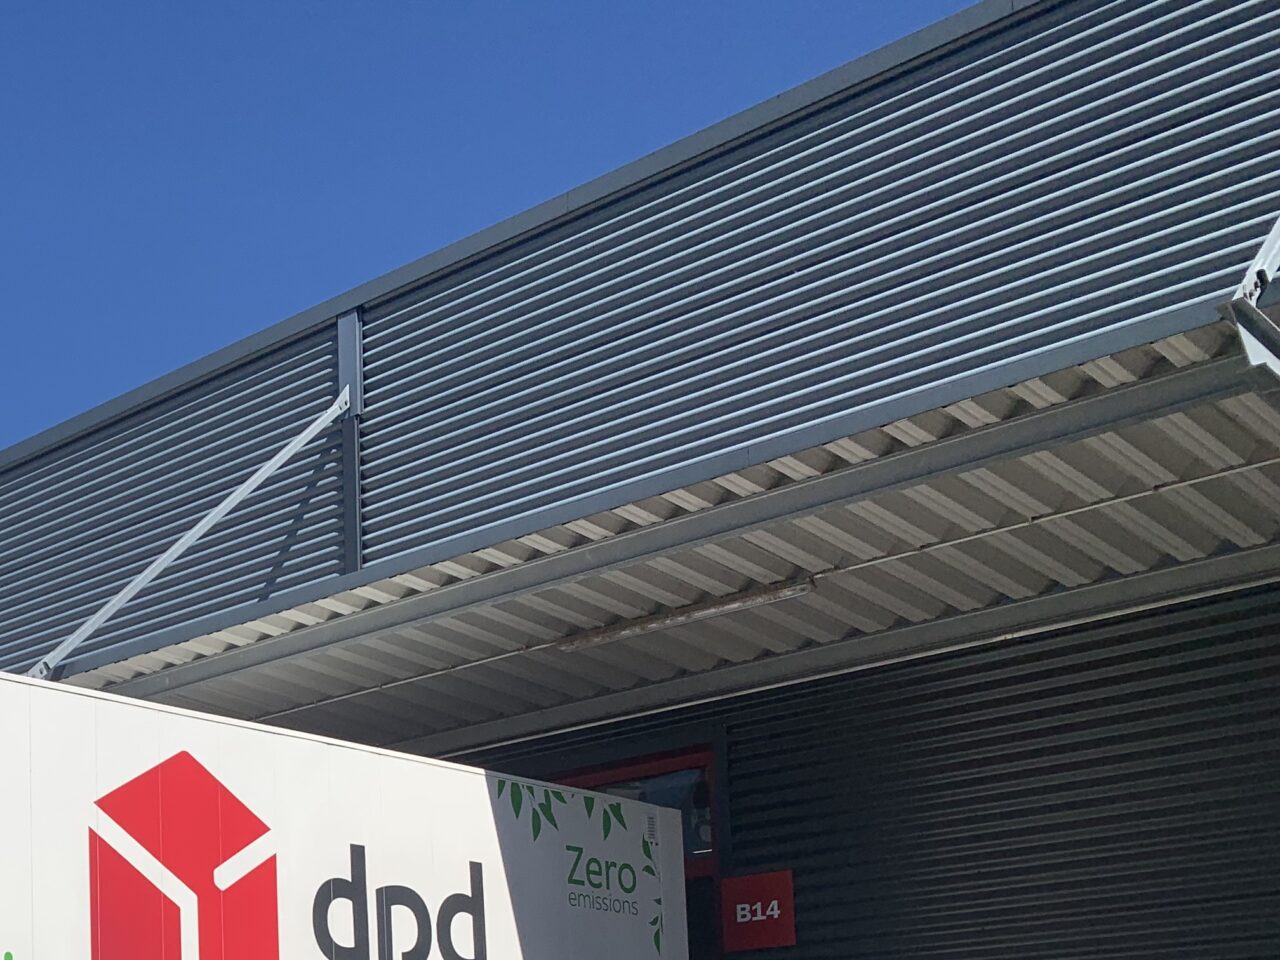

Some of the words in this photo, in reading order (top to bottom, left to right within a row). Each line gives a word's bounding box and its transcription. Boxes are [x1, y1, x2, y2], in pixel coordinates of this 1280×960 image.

[565, 845, 637, 893] Zero
[568, 890, 639, 916] emissions
[736, 899, 781, 923] B14
